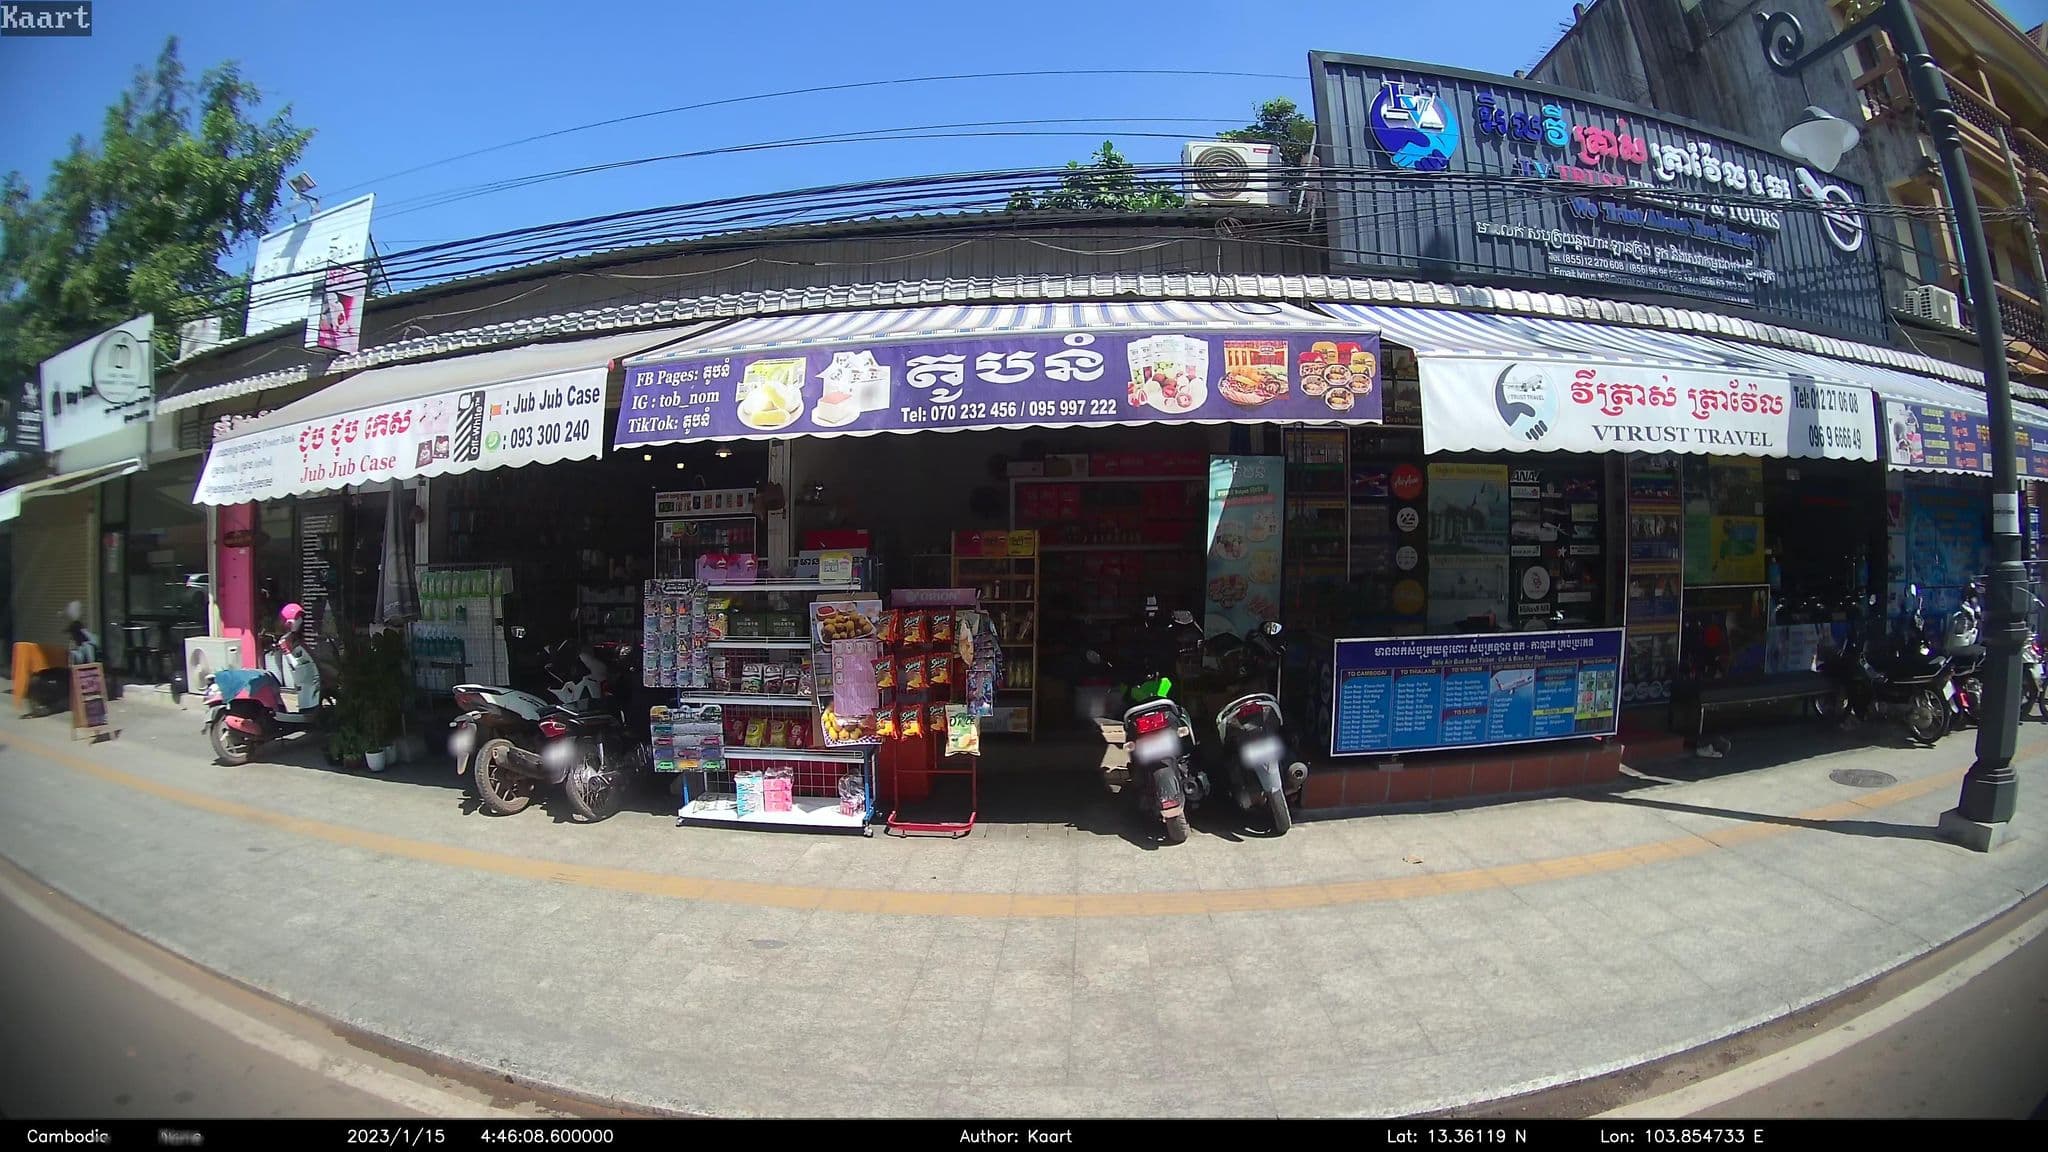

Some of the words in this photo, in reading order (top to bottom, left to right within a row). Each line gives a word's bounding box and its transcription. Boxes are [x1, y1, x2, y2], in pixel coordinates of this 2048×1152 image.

[1725, 201, 1780, 230] TOURS
[635, 371, 654, 387] FB
[656, 369, 698, 387] Pages:
[513, 391, 535, 414] Jub
[539, 388, 563, 411] Jub
[567, 385, 600, 406] Case
[631, 394, 648, 410] IG
[659, 390, 720, 408] tob_nom
[901, 406, 926, 423] Tel:
[931, 404, 955, 421] 070
[960, 402, 986, 419] 232
[990, 402, 1017, 418] 456
[1020, 400, 1025, 417] /
[1029, 400, 1055, 417] 095
[1060, 399, 1085, 416] 997
[1090, 398, 1117, 415] 222
[1794, 386, 1810, 409] Tel:
[1810, 387, 1826, 411] 012
[1827, 390, 1837, 412] 27
[1838, 391, 1848, 413] 06
[1849, 392, 1859, 414] 08
[510, 426, 533, 449] 093
[537, 422, 561, 445] 300
[564, 418, 590, 442] 240
[628, 414, 678, 434] TikTok:
[1592, 424, 1690, 443] VTRUST
[1694, 428, 1774, 447] TRAVEL
[1808, 424, 1825, 448] 096
[1827, 426, 1833, 448] 9
[1834, 427, 1851, 450] 6666
[1852, 428, 1862, 450] 49
[300, 466, 326, 484] Jub
[329, 457, 356, 479] Jub
[360, 453, 397, 473] Case
[919, 591, 961, 600] ORION
